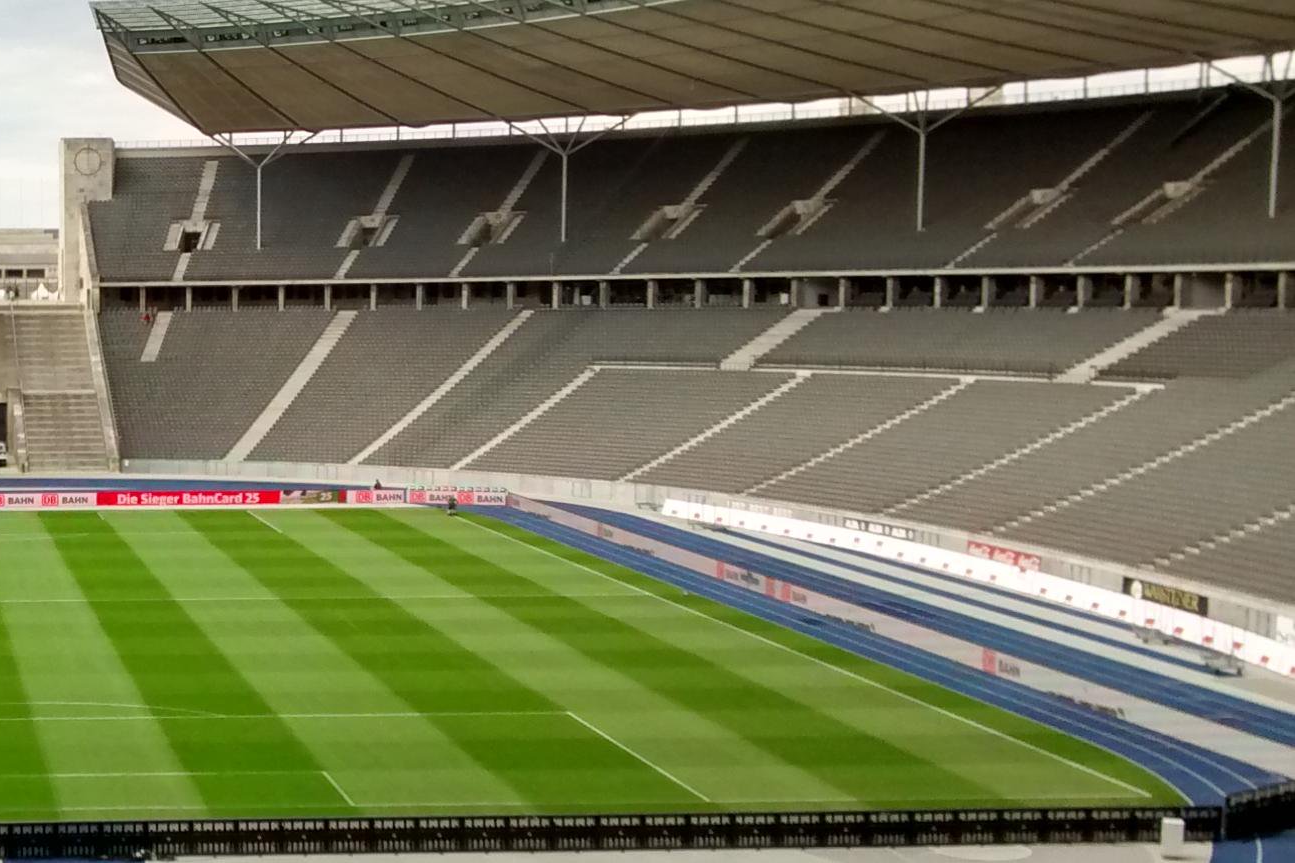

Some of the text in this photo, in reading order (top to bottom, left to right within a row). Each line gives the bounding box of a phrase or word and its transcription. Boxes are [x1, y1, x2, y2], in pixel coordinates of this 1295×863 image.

[7, 496, 35, 505] BAHN
[43, 494, 89, 506] DB BAHN
[117, 492, 260, 506] Die Sieger BahnCard 25
[376, 493, 402, 501] BAHN
[477, 495, 504, 503] BAHN
